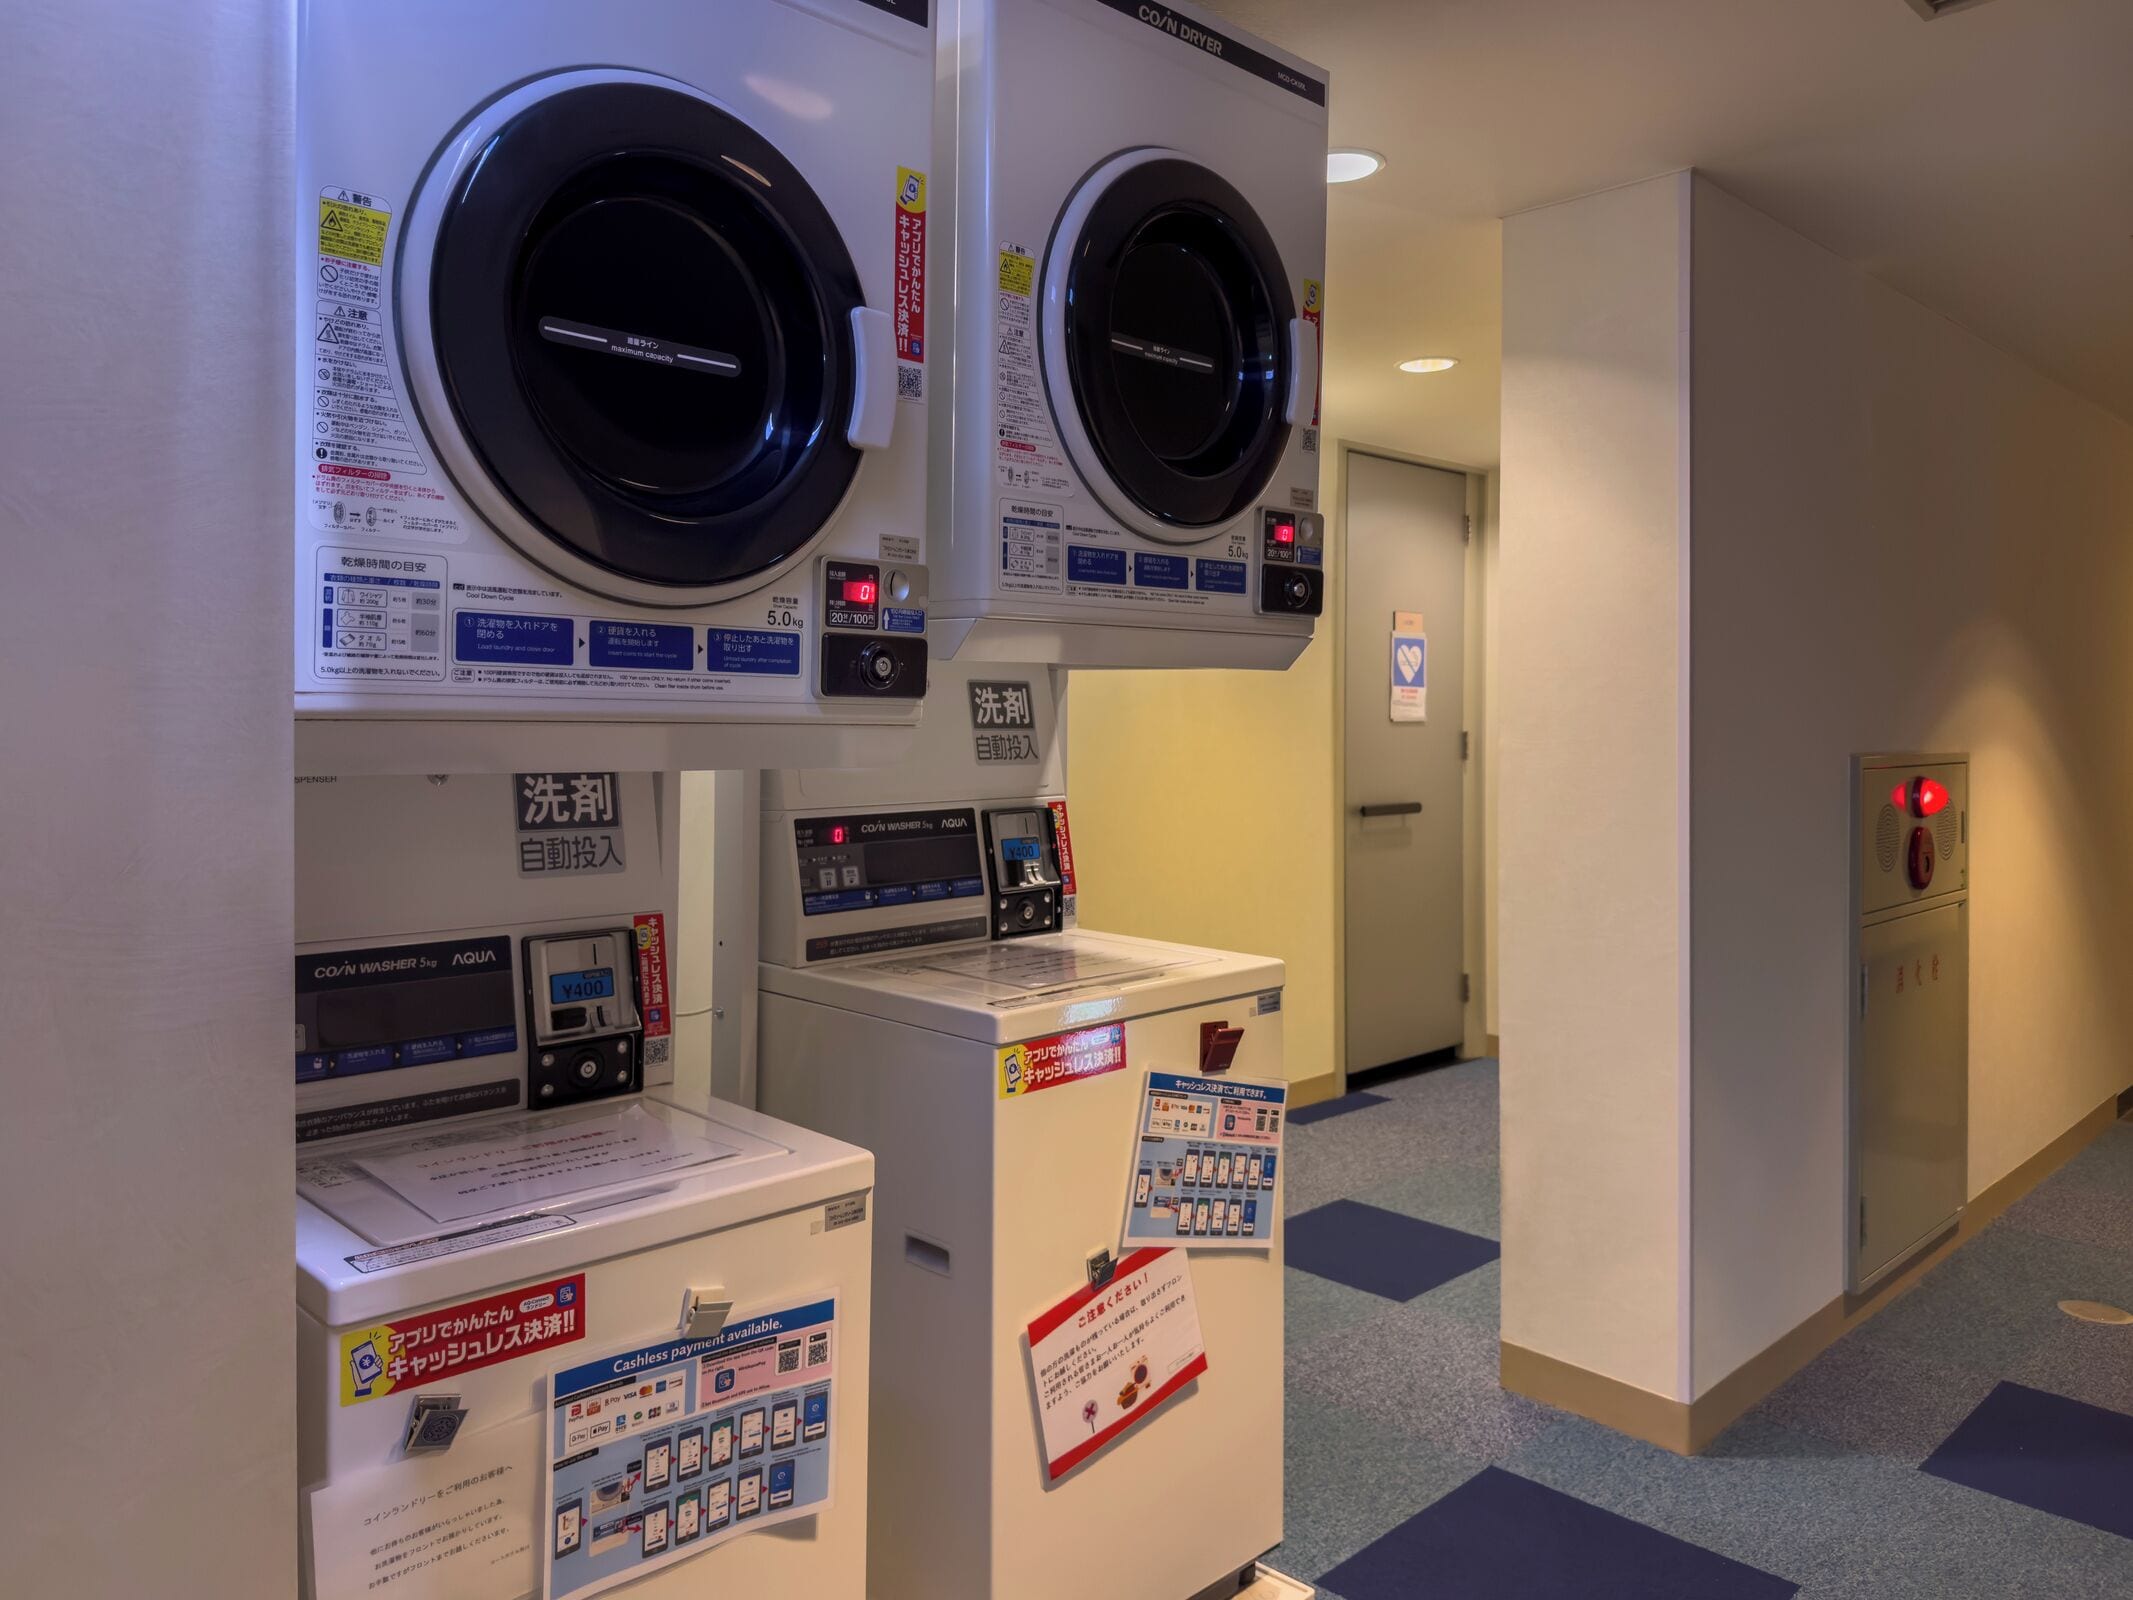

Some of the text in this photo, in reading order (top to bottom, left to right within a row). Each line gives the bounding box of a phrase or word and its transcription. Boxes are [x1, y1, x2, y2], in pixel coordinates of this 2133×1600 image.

[1180, 25, 1223, 56] DRYER
[352, 193, 372, 207] 警告
[910, 217, 922, 314] アプリでかんたん
[347, 308, 368, 321] 注意
[611, 344, 674, 364] maximum capacity
[1011, 505, 1054, 518] 乾燥時間の目安
[340, 556, 427, 572] 乾燥時間の目安
[772, 596, 799, 605] 乾燥容量
[860, 585, 870, 600] 0
[477, 617, 558, 632] 洗濯物を入れドアを
[608, 626, 657, 637] 硬貨を入れる
[476, 630, 504, 639] 閉める
[608, 638, 660, 647] 運転を開始します
[723, 633, 794, 646] 停止したあと洗濯物を
[724, 643, 752, 652] 取り出す
[975, 686, 1031, 724] 洗剤
[976, 734, 1039, 760] 自動投入
[523, 774, 614, 824] 洗剤
[887, 820, 921, 832] WASHER
[941, 817, 968, 829] AQUA
[834, 828, 844, 843] 0
[520, 835, 623, 872] 自動投入
[359, 958, 417, 974] WASHER
[419, 957, 438, 969] 5kg
[452, 950, 497, 966] AQUA
[648, 917, 664, 1004] キャッシュレス決済
[1024, 1041, 1088, 1064] アプリでかんたん
[1175, 1080, 1267, 1100] キャッシュレス決済でご利用できます。
[389, 1306, 514, 1354] アプリでかんたん
[613, 1350, 669, 1374] Cashless
[671, 1333, 725, 1362] payment
[727, 1319, 783, 1344] available.
[623, 1391, 637, 1400] VISA
[597, 1425, 609, 1433] Pay
[363, 1464, 513, 1527] コインランドリーをご利用のお客様へ
[368, 1528, 510, 1590] お手数ですがフロントまでお越しくださいませ。
